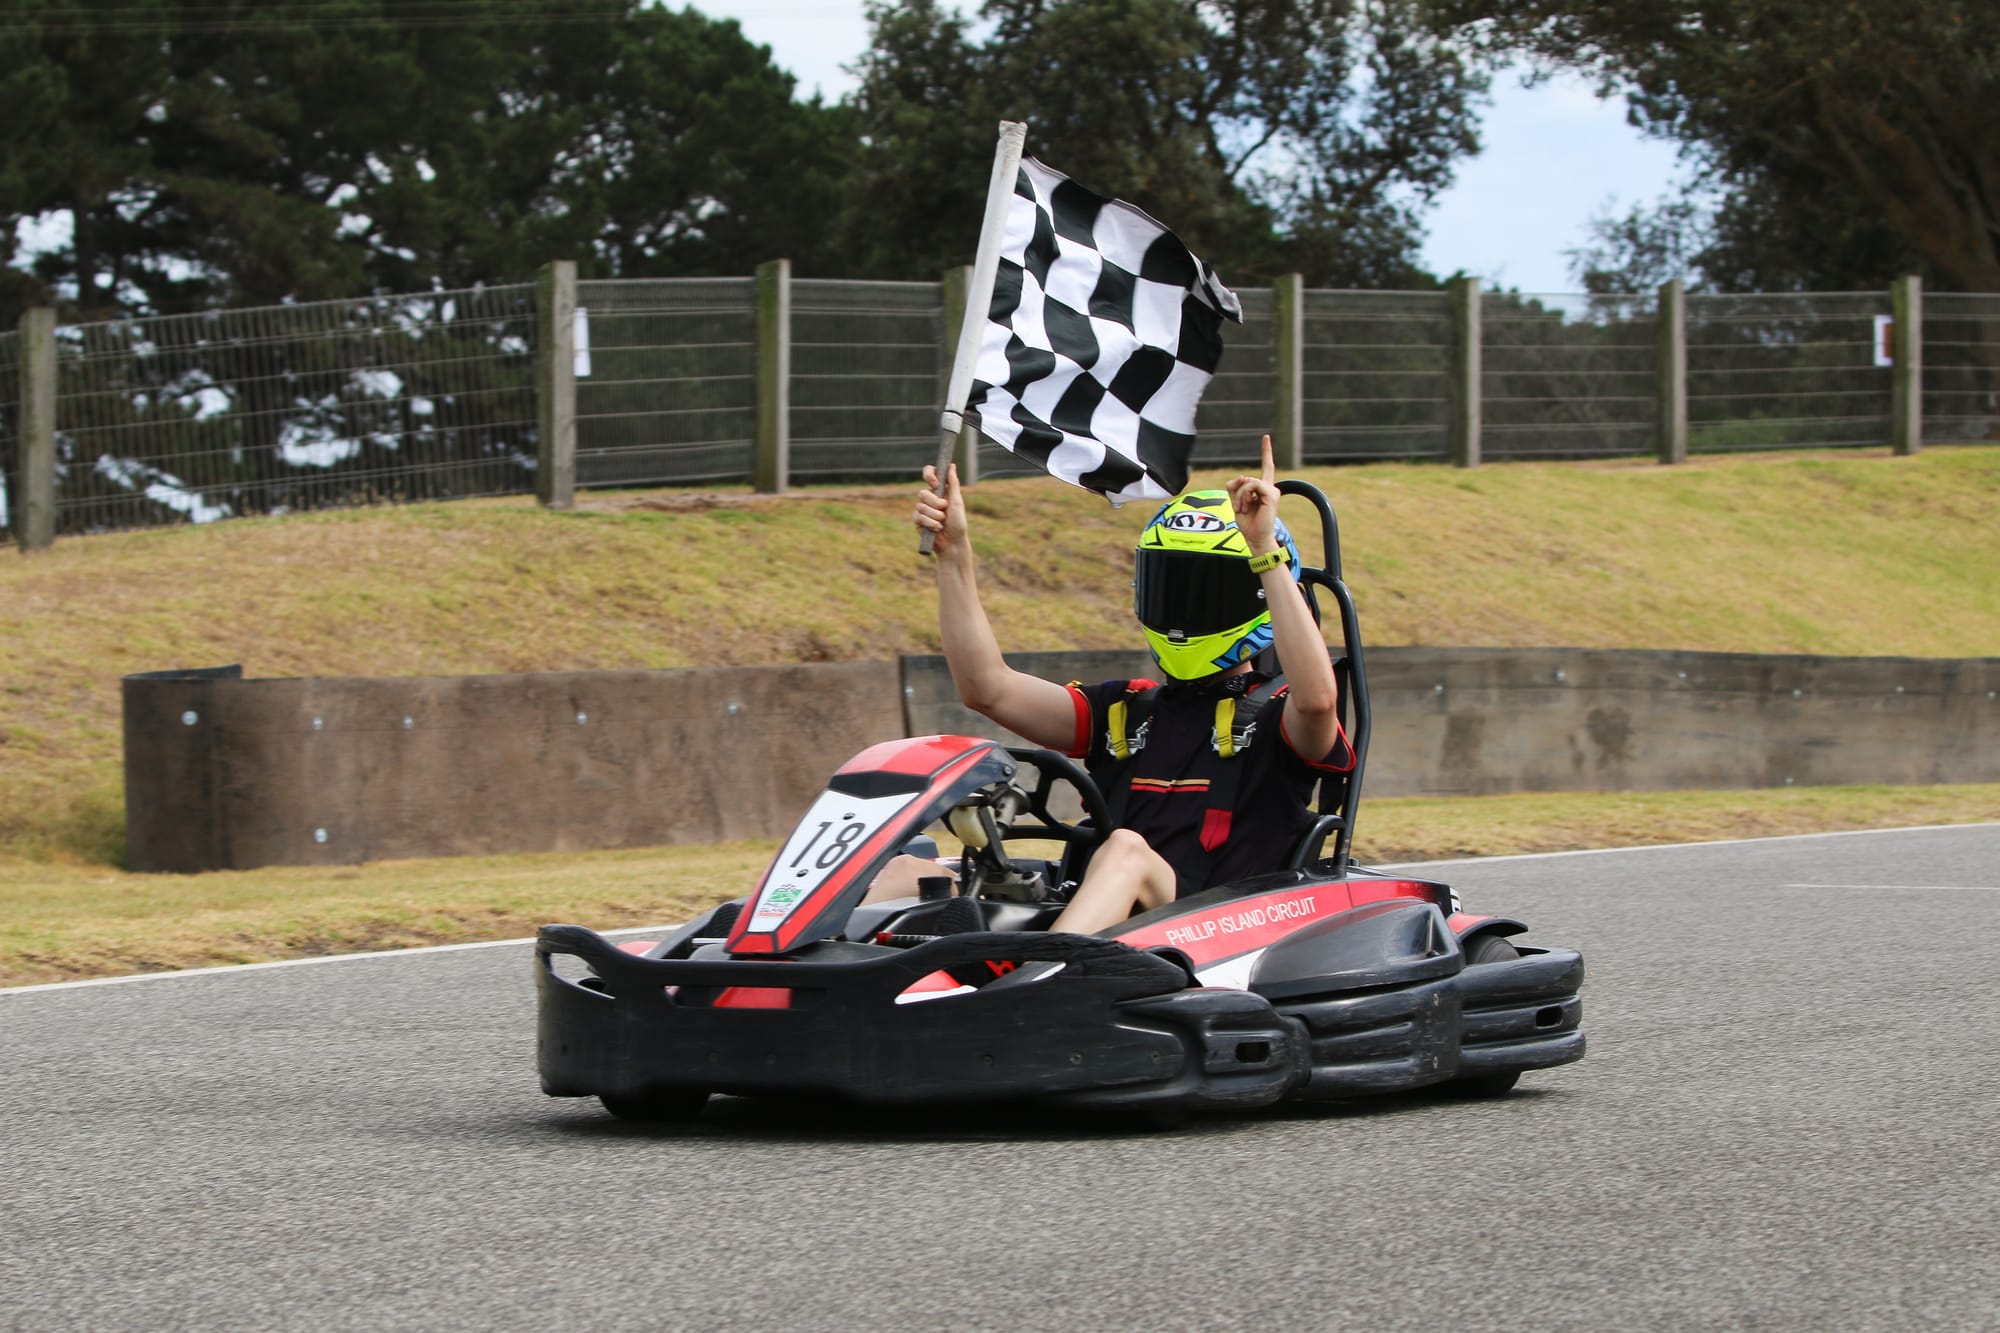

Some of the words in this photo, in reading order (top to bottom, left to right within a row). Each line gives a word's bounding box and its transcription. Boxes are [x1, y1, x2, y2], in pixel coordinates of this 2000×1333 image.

[1168, 515, 1220, 529] KYT
[790, 821, 866, 870] 18
[1166, 920, 1217, 946] PHILLIP
[1217, 909, 1266, 934] ISLAND
[1267, 897, 1317, 922] CIRCUIT
